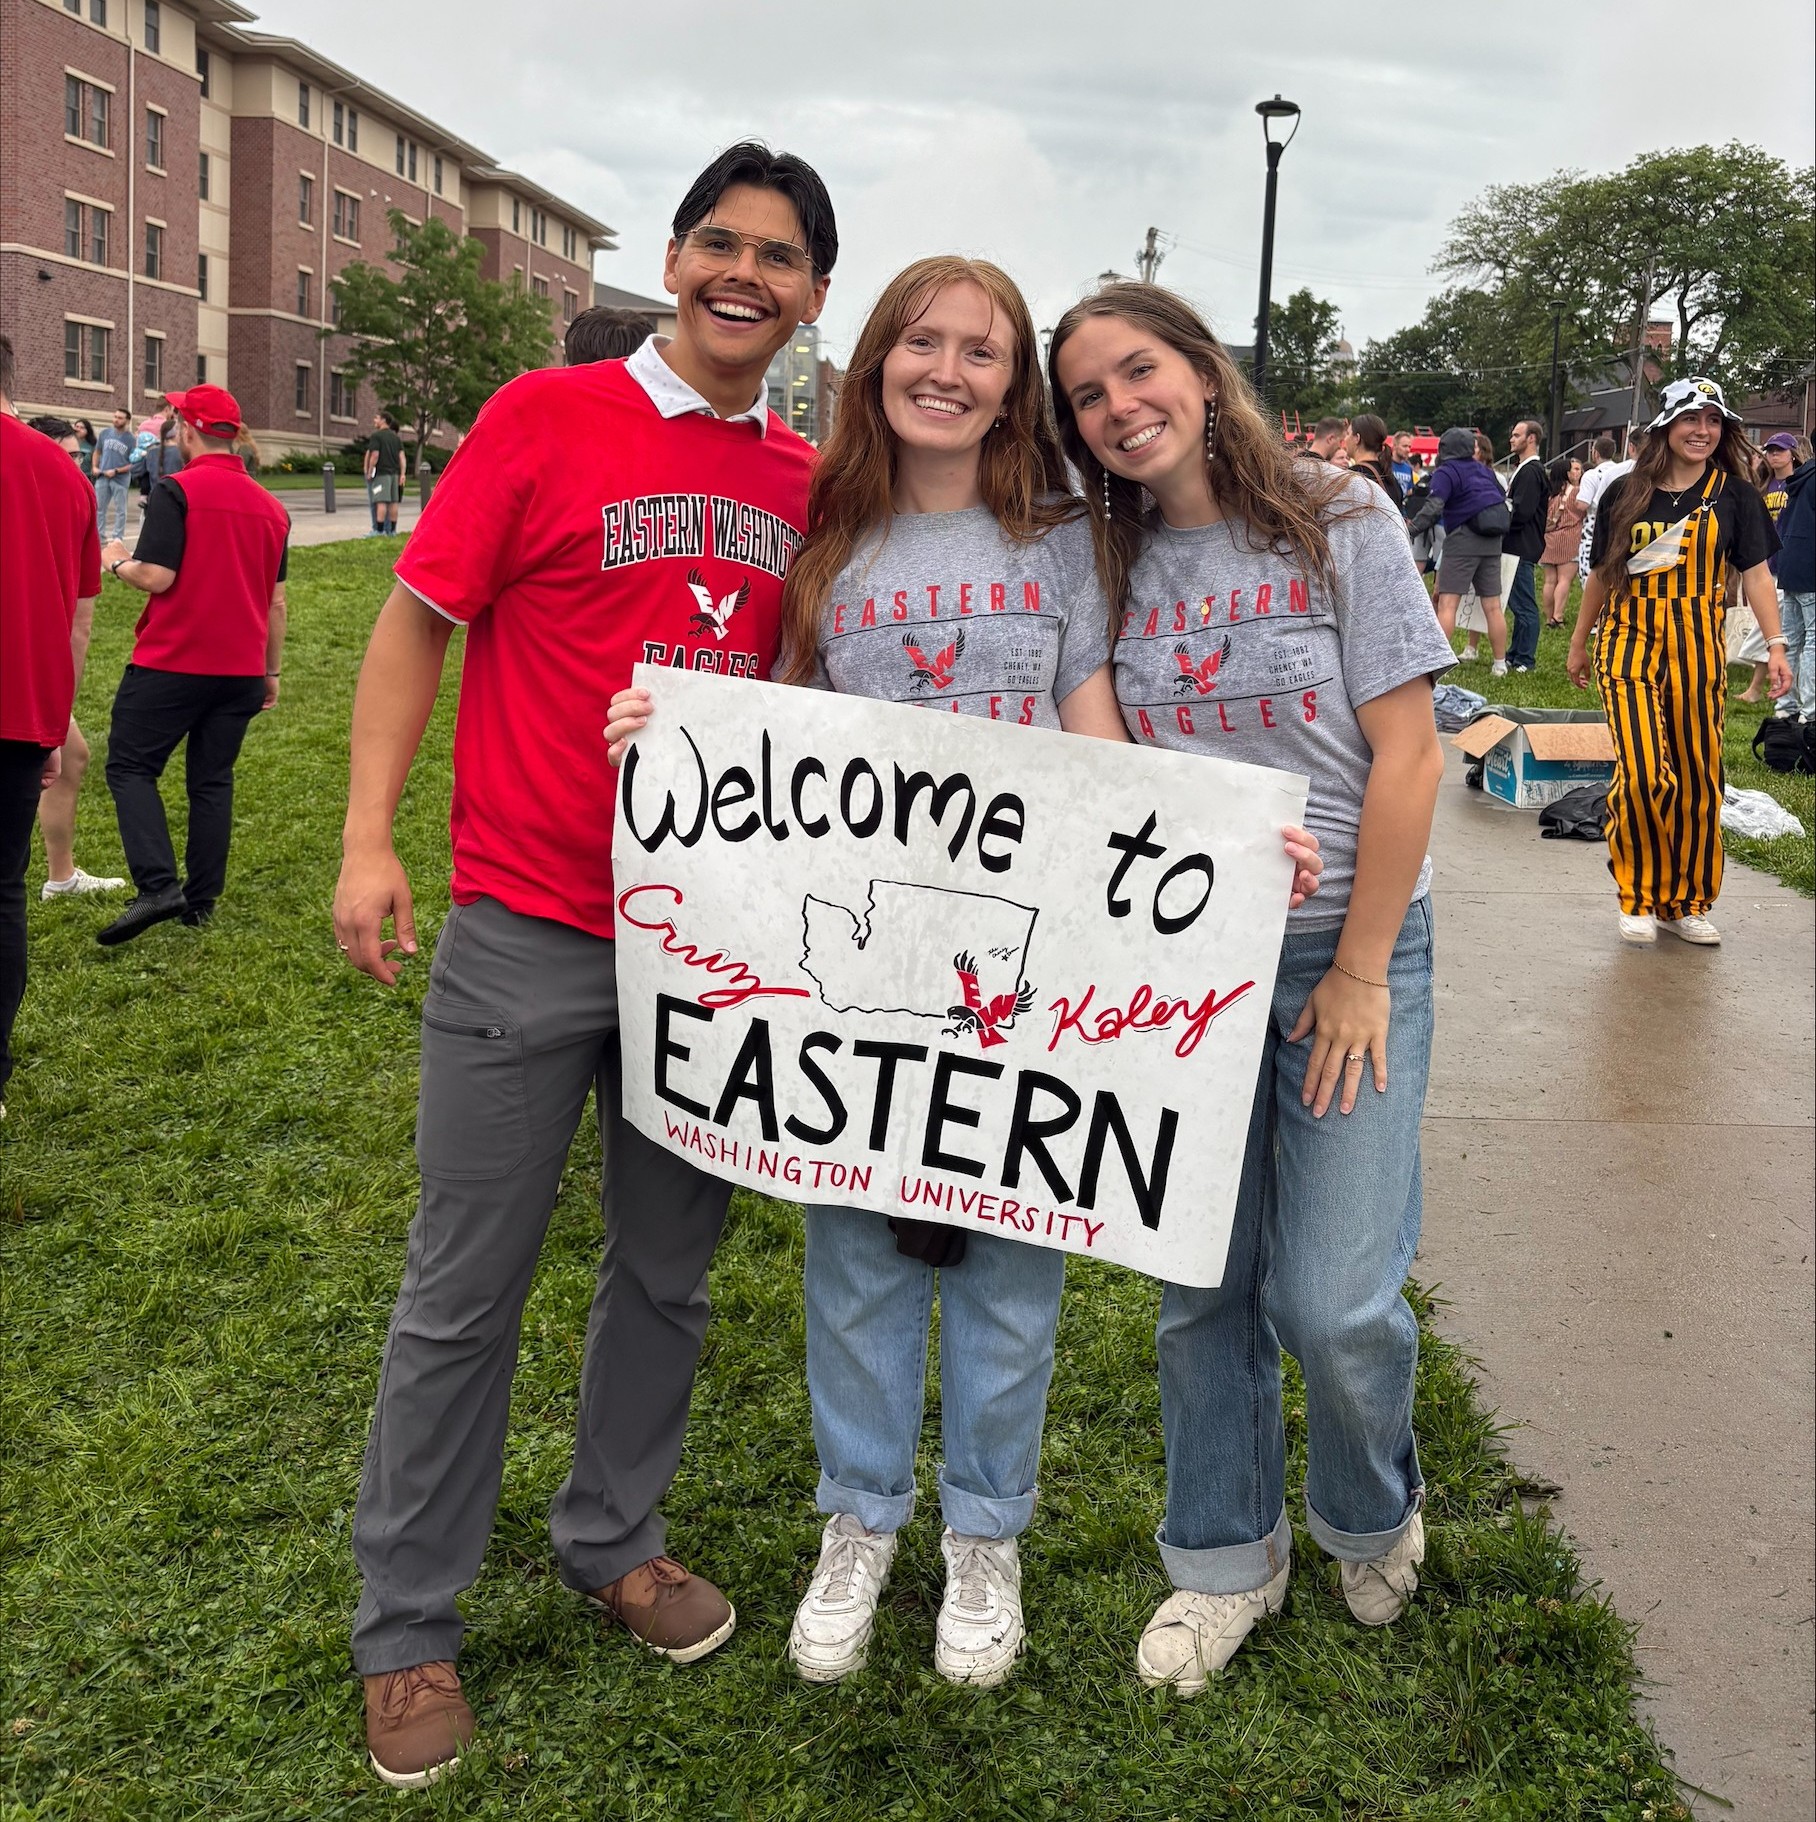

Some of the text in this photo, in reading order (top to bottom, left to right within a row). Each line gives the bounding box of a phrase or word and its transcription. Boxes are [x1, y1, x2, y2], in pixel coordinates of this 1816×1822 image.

[602, 494, 707, 571] EASTERN
[833, 581, 1041, 634] EASTERN
[1119, 579, 1309, 638] EASTERN
[1007, 675, 1039, 685] GO EAGLES
[1275, 670, 1315, 687] GO EAGLES
[1137, 690, 1317, 738] AGLES
[622, 726, 1214, 934] Welcome to
[617, 884, 810, 1008] Cruz
[653, 992, 1179, 1229] EASTERN
[664, 1110, 1105, 1247] WASHINGTON UNIVERSITY
